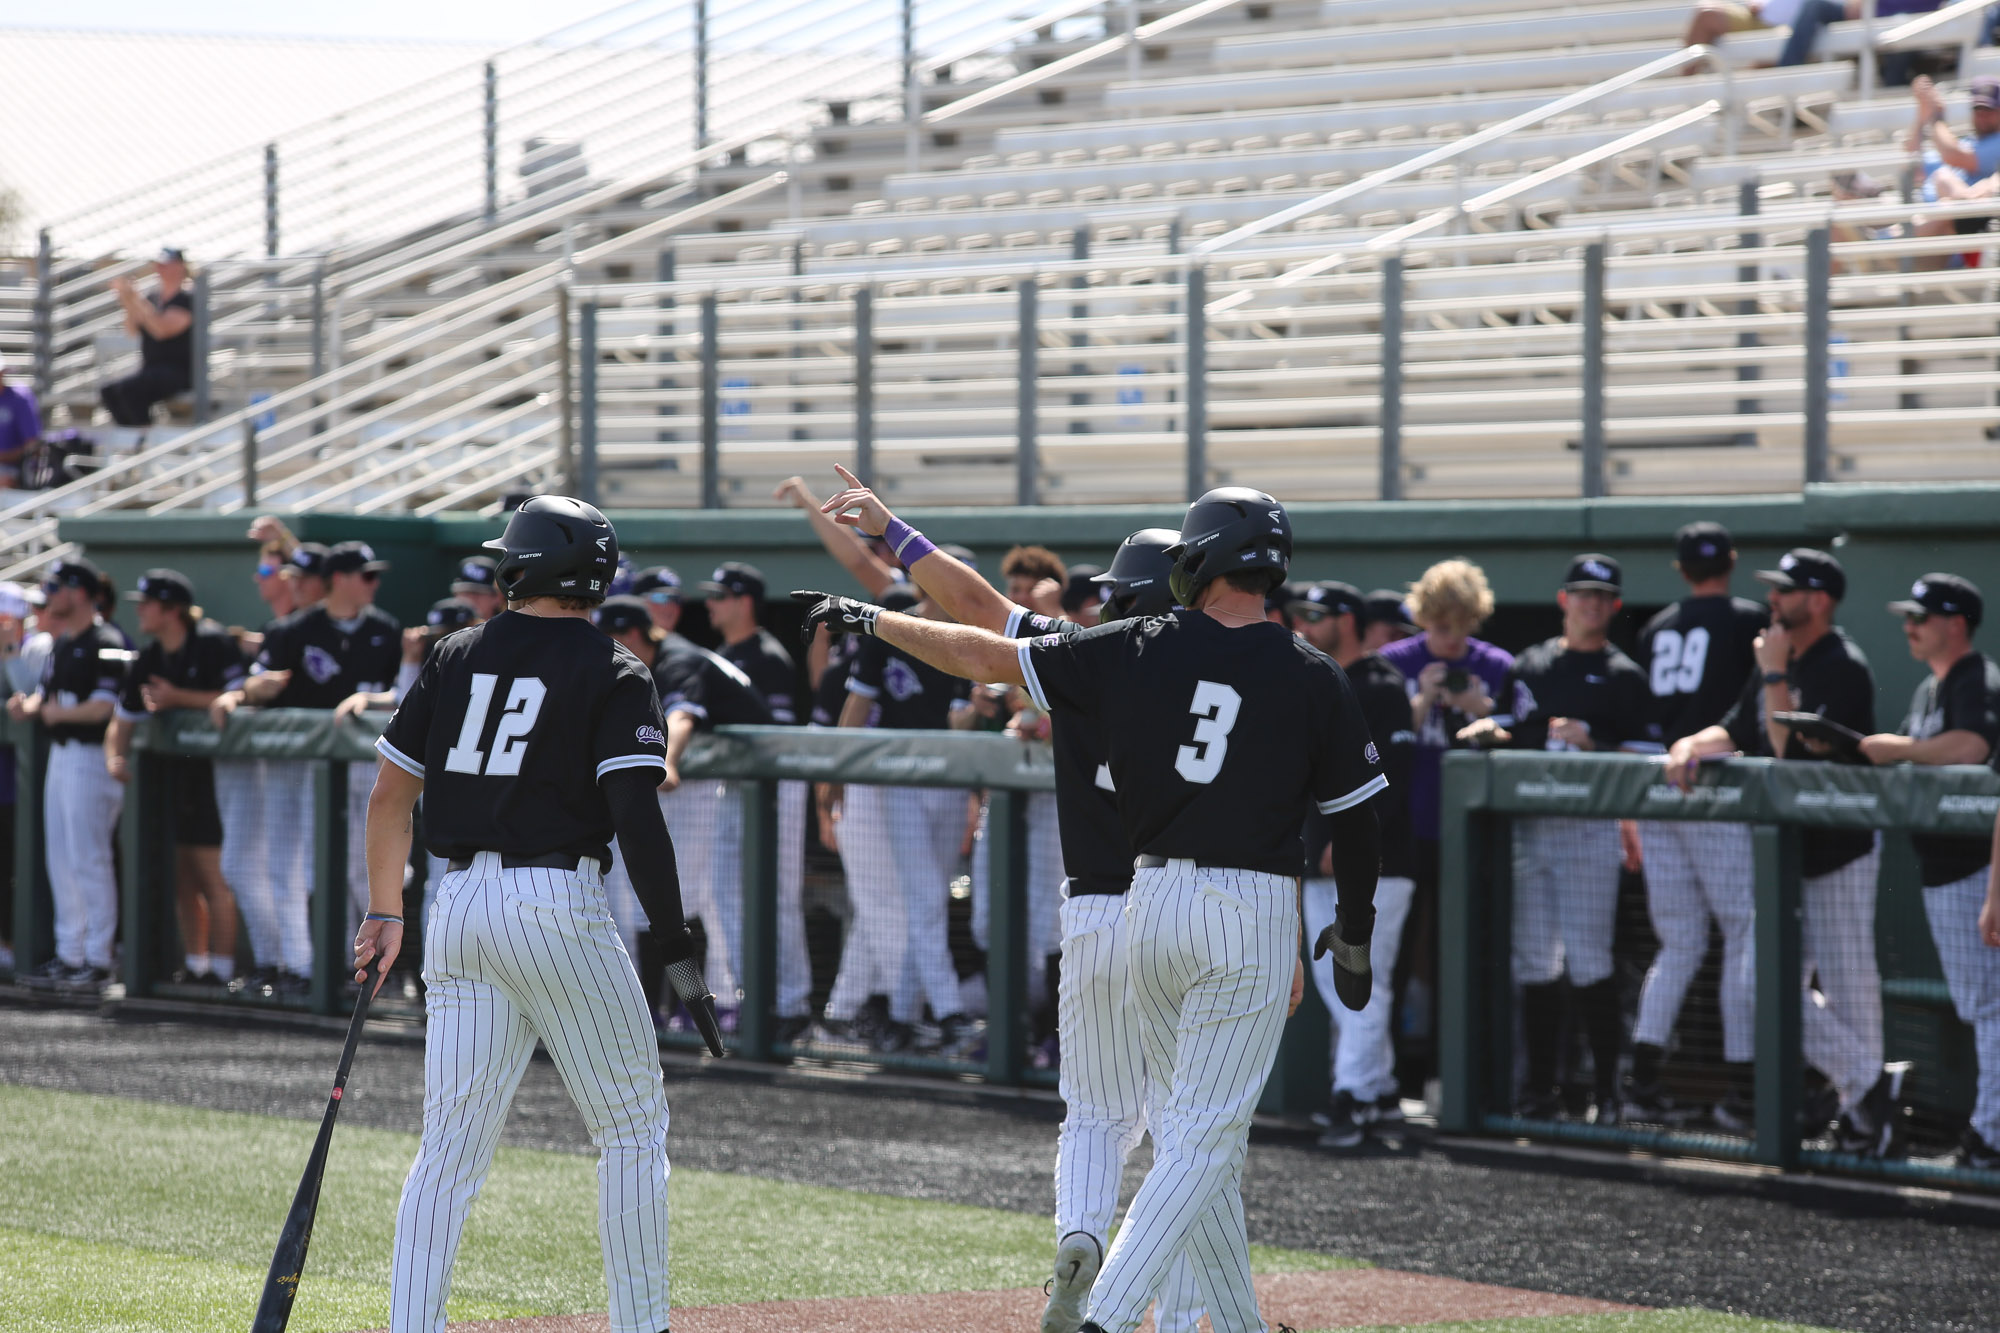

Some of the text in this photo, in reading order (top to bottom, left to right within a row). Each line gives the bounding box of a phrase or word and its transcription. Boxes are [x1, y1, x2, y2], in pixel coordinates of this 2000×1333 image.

[1197, 532, 1220, 547] EASTON
[518, 552, 543, 560] EASTON
[560, 580, 576, 588] WAC
[589, 579, 601, 591] 12
[1649, 627, 1710, 697] 29
[444, 672, 548, 776] 12
[1174, 679, 1243, 784] 3
